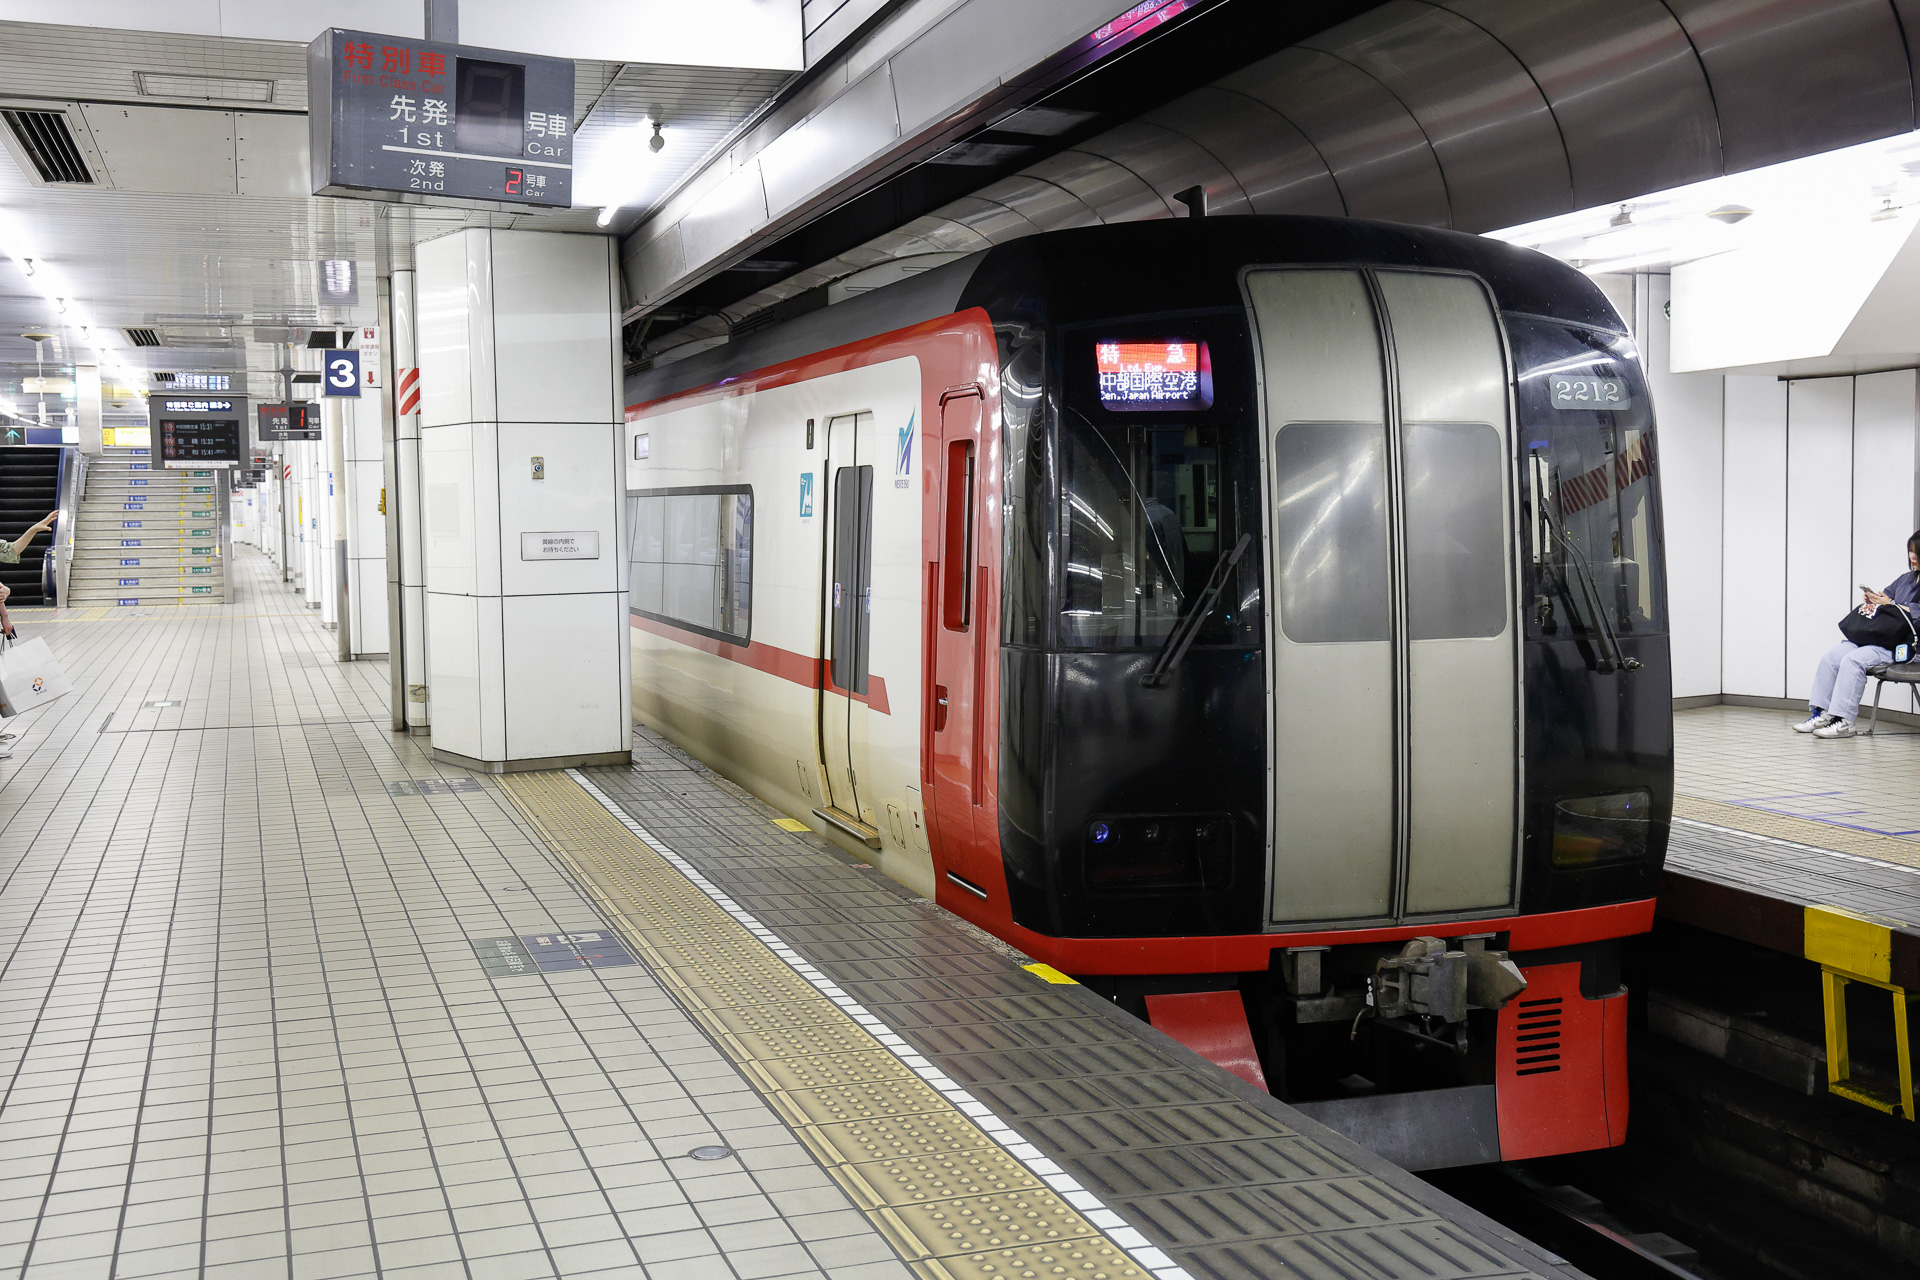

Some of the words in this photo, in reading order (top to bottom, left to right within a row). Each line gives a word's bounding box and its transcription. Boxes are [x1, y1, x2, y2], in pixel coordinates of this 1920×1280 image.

[344, 41, 447, 78] 特別車
[343, 70, 374, 86] First
[379, 74, 417, 91] Class
[422, 80, 445, 94] Car
[390, 95, 449, 126] 先発
[527, 111, 567, 140] 号車
[398, 128, 443, 148] 1st
[527, 142, 564, 157] Car
[410, 159, 445, 178] 次発
[410, 178, 444, 191] 2nd
[505, 170, 522, 194] 2
[525, 173, 547, 188] 号車
[525, 188, 545, 197] Car
[329, 358, 356, 388] 3
[1099, 371, 1198, 391] 中部国際空港
[1121, 390, 1150, 401] Japan
[1151, 390, 1189, 400] Airport
[1555, 381, 1619, 402] 2212
[300, 409, 305, 427] 1
